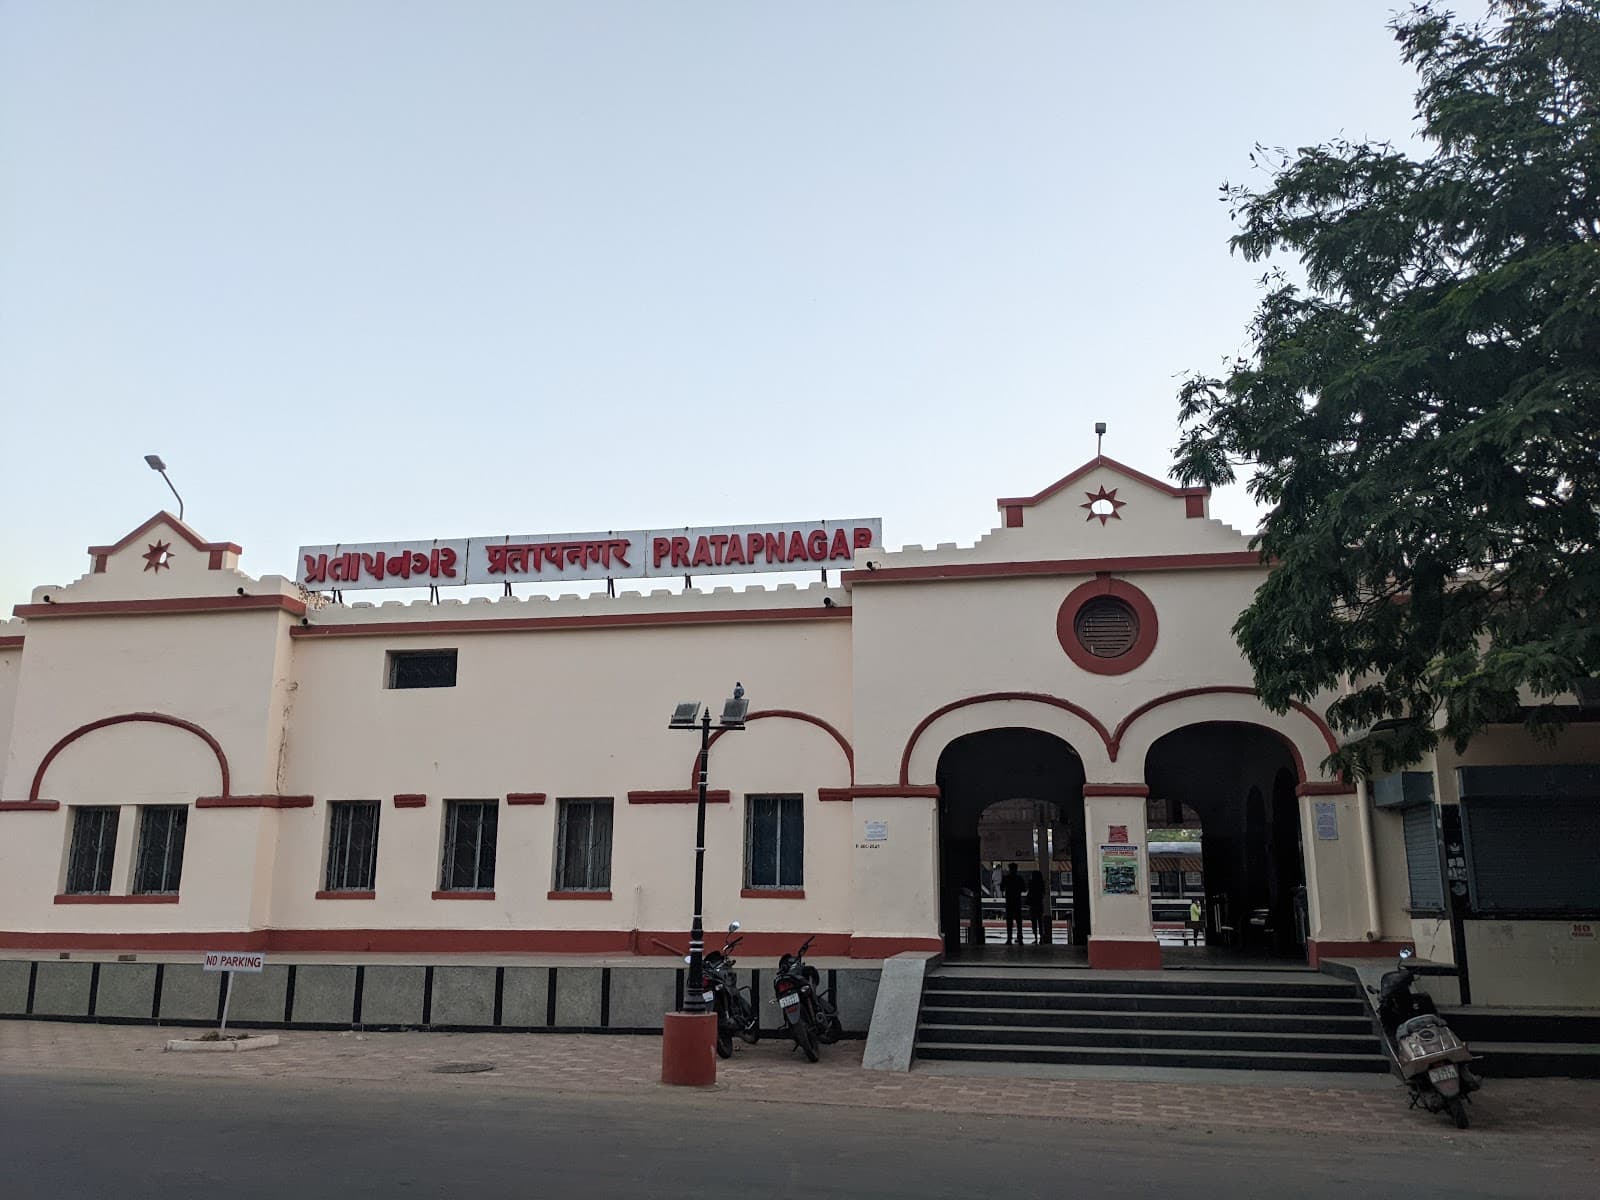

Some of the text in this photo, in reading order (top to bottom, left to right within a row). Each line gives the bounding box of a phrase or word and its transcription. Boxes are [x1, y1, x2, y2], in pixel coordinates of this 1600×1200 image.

[304, 547, 457, 583] પ્રતાપનગર
[485, 539, 632, 574] प्रतापनगर
[654, 528, 872, 568] PRATAPNAGAR
[206, 955, 261, 968] NO PARKING
